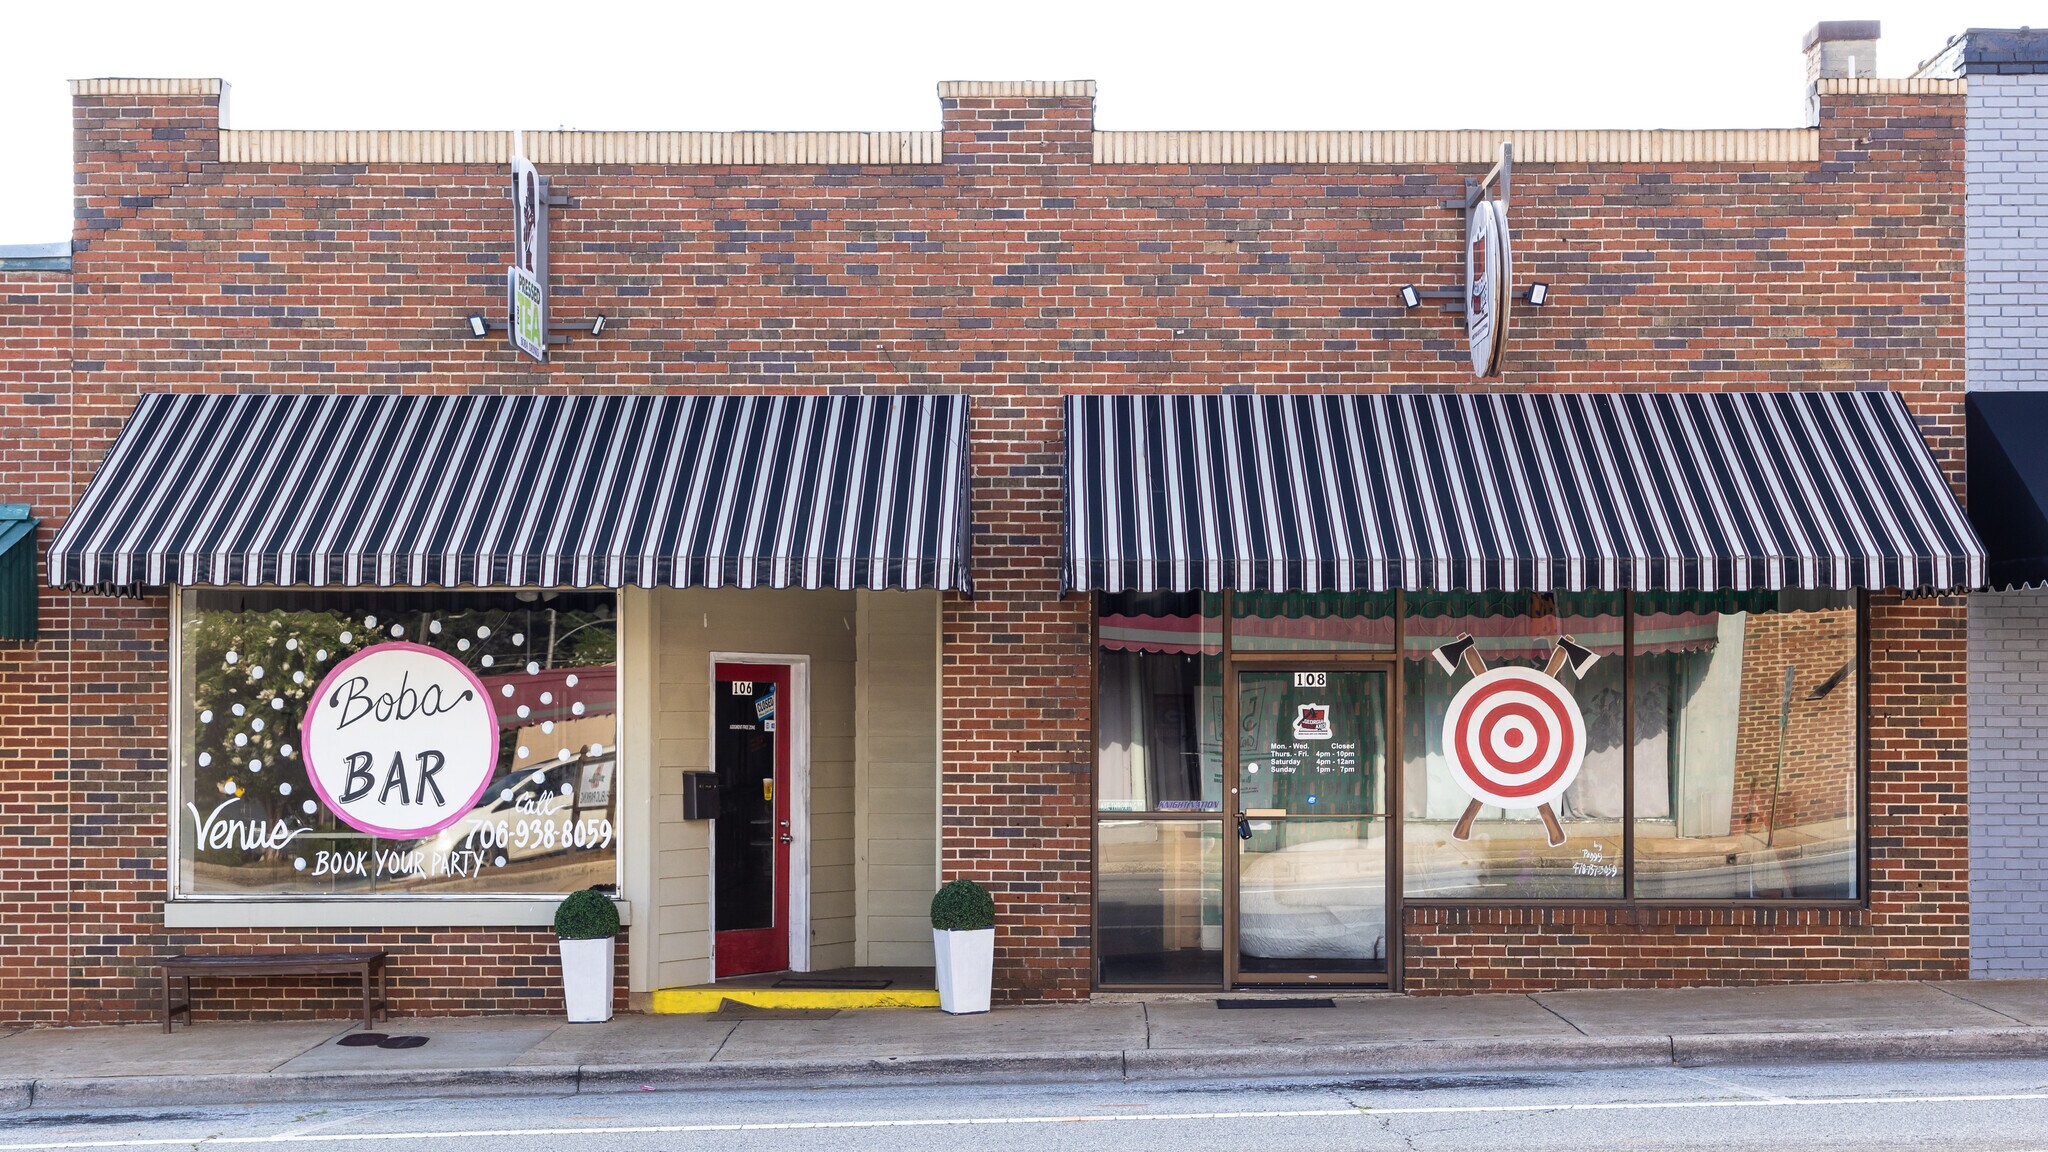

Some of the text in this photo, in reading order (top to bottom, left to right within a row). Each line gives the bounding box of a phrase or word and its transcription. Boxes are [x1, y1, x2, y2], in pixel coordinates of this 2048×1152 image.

[518, 273, 541, 306] PRESSED
[517, 290, 541, 348] TEA
[733, 682, 752, 694] 106
[1296, 673, 1326, 686] 108
[330, 670, 473, 731] Boba
[756, 696, 774, 713] CLOSED
[338, 750, 446, 807] BAR
[1157, 800, 1220, 809] KNIGHT NATION
[186, 797, 314, 851] Venue
[465, 818, 613, 850] 706-938-8059
[311, 849, 485, 880] BOOK YOUR PARTY
